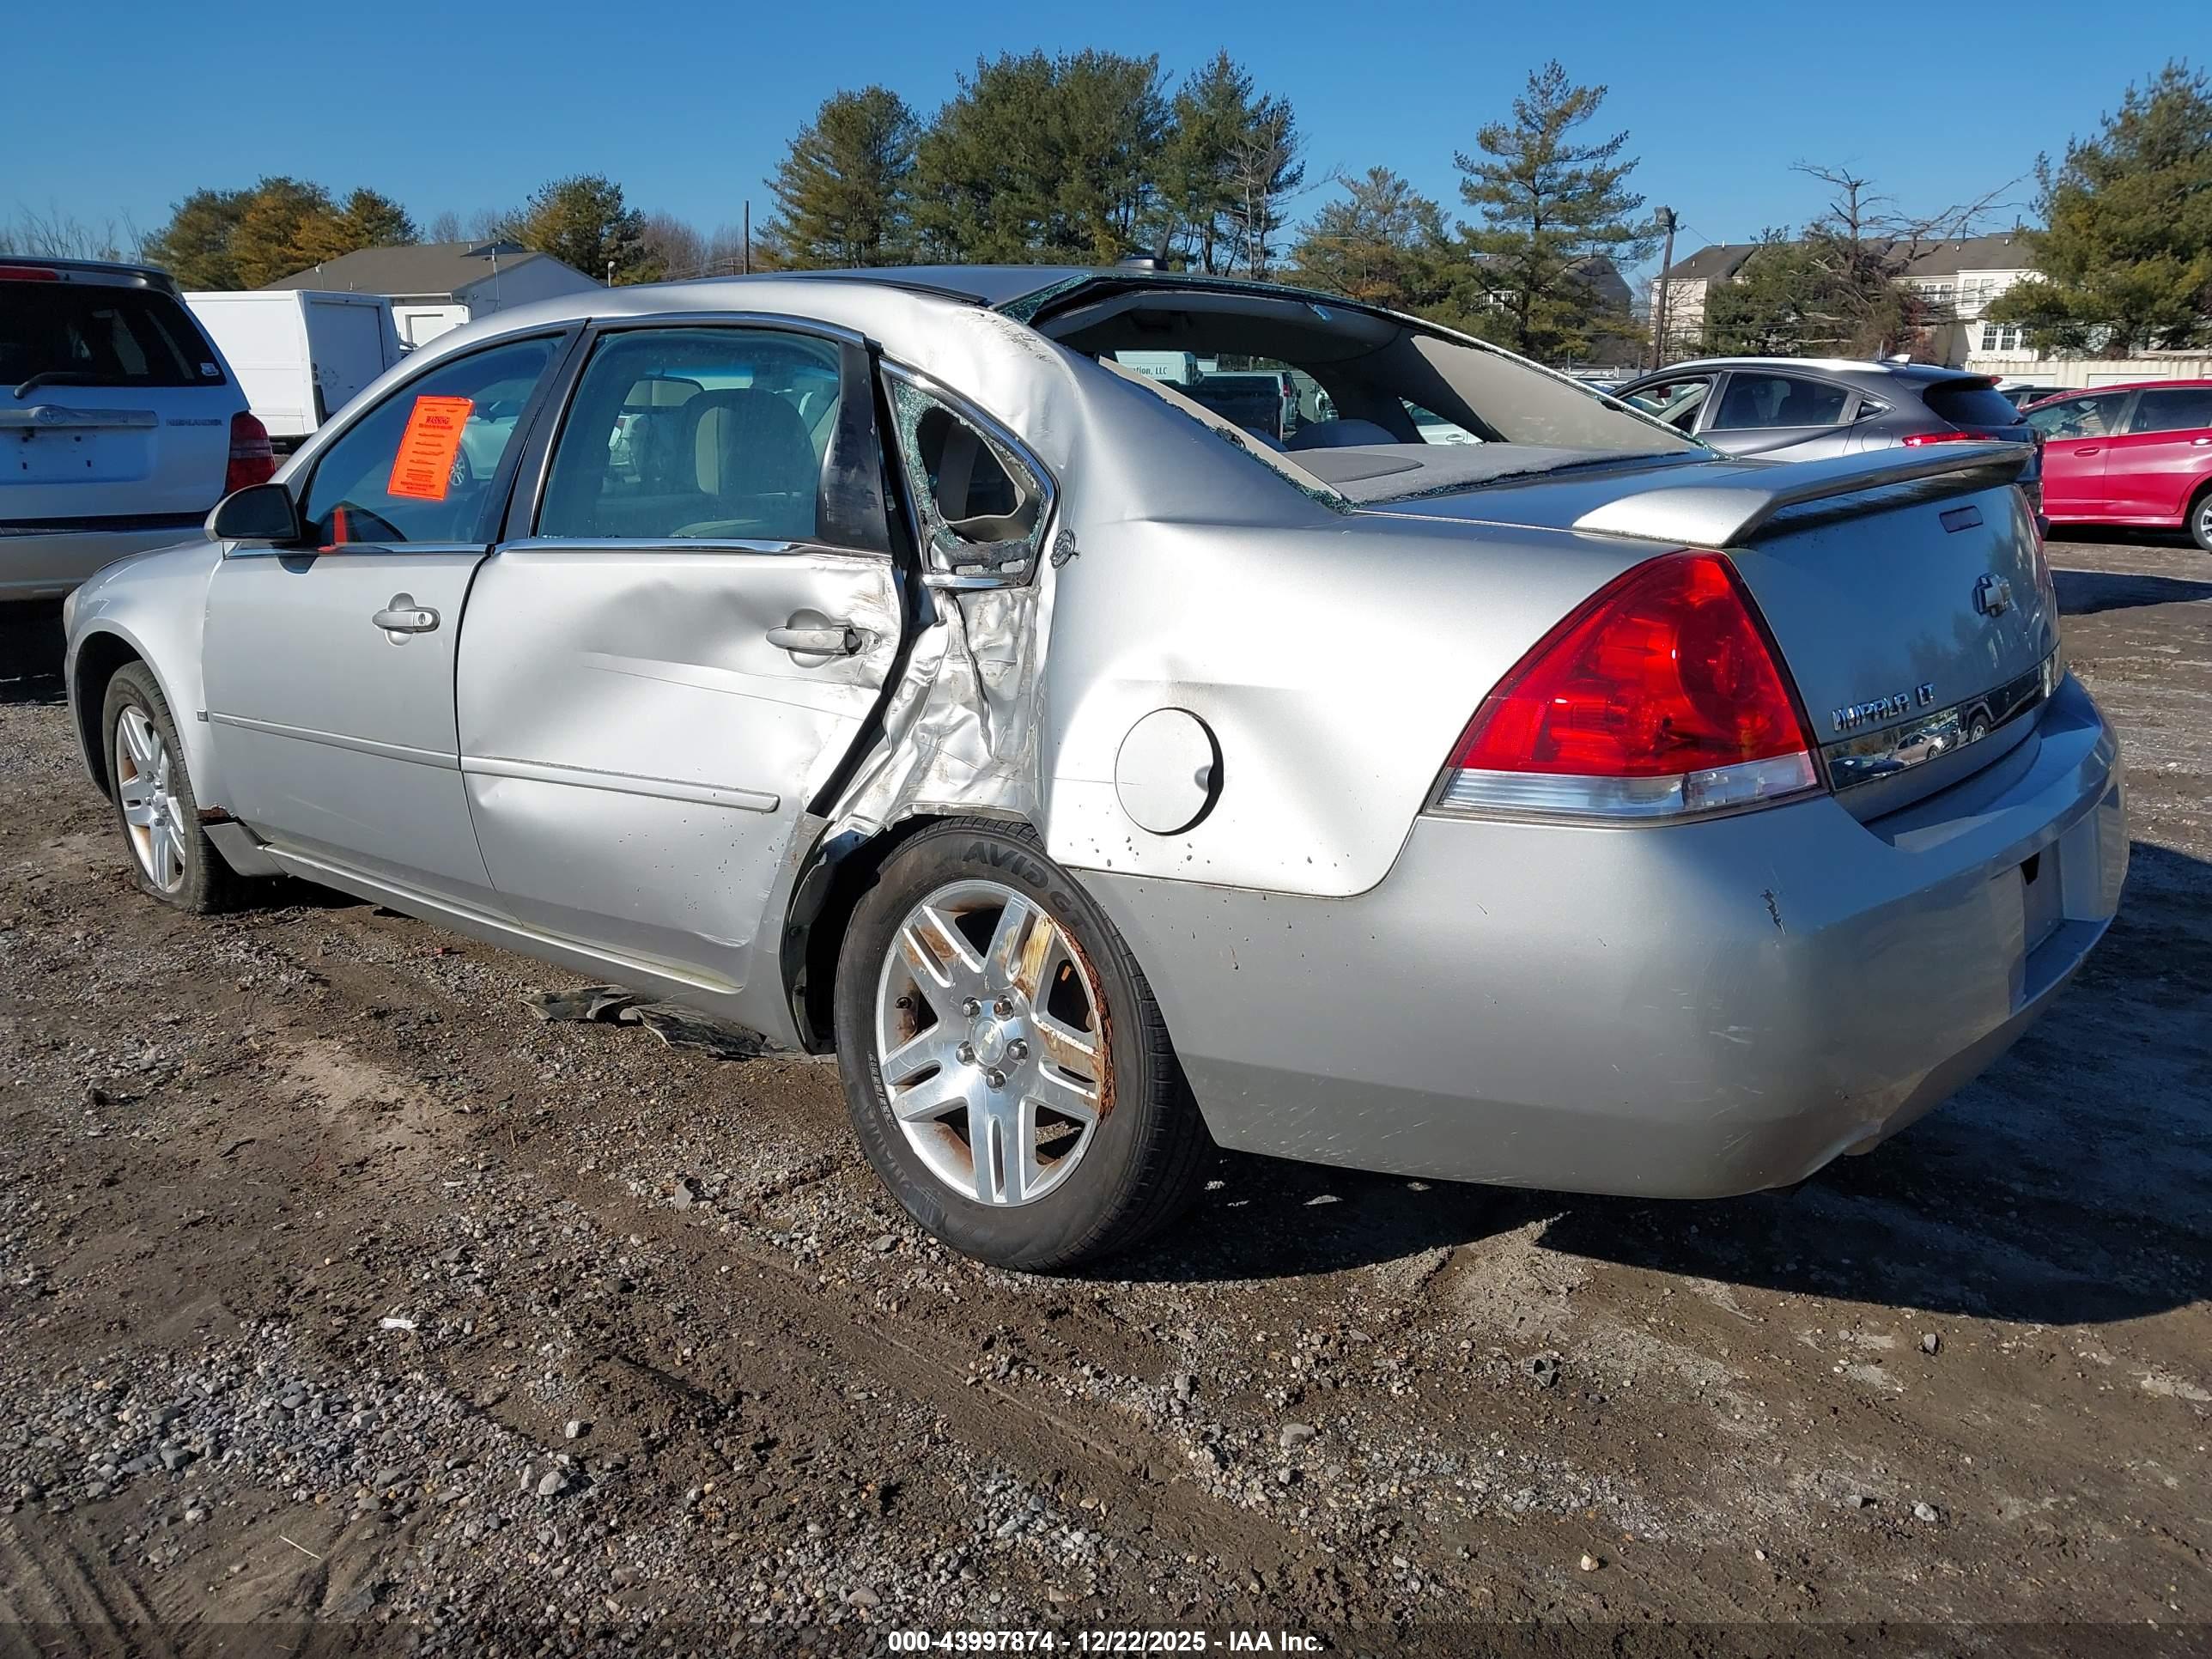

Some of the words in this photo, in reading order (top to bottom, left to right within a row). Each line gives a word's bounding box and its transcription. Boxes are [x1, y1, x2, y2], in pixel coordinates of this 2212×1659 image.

[1133, 366, 1153, 375] tion,
[1155, 366, 1168, 375] LLC
[1832, 692, 1911, 732] IMPALA
[1915, 683, 1935, 707] LT
